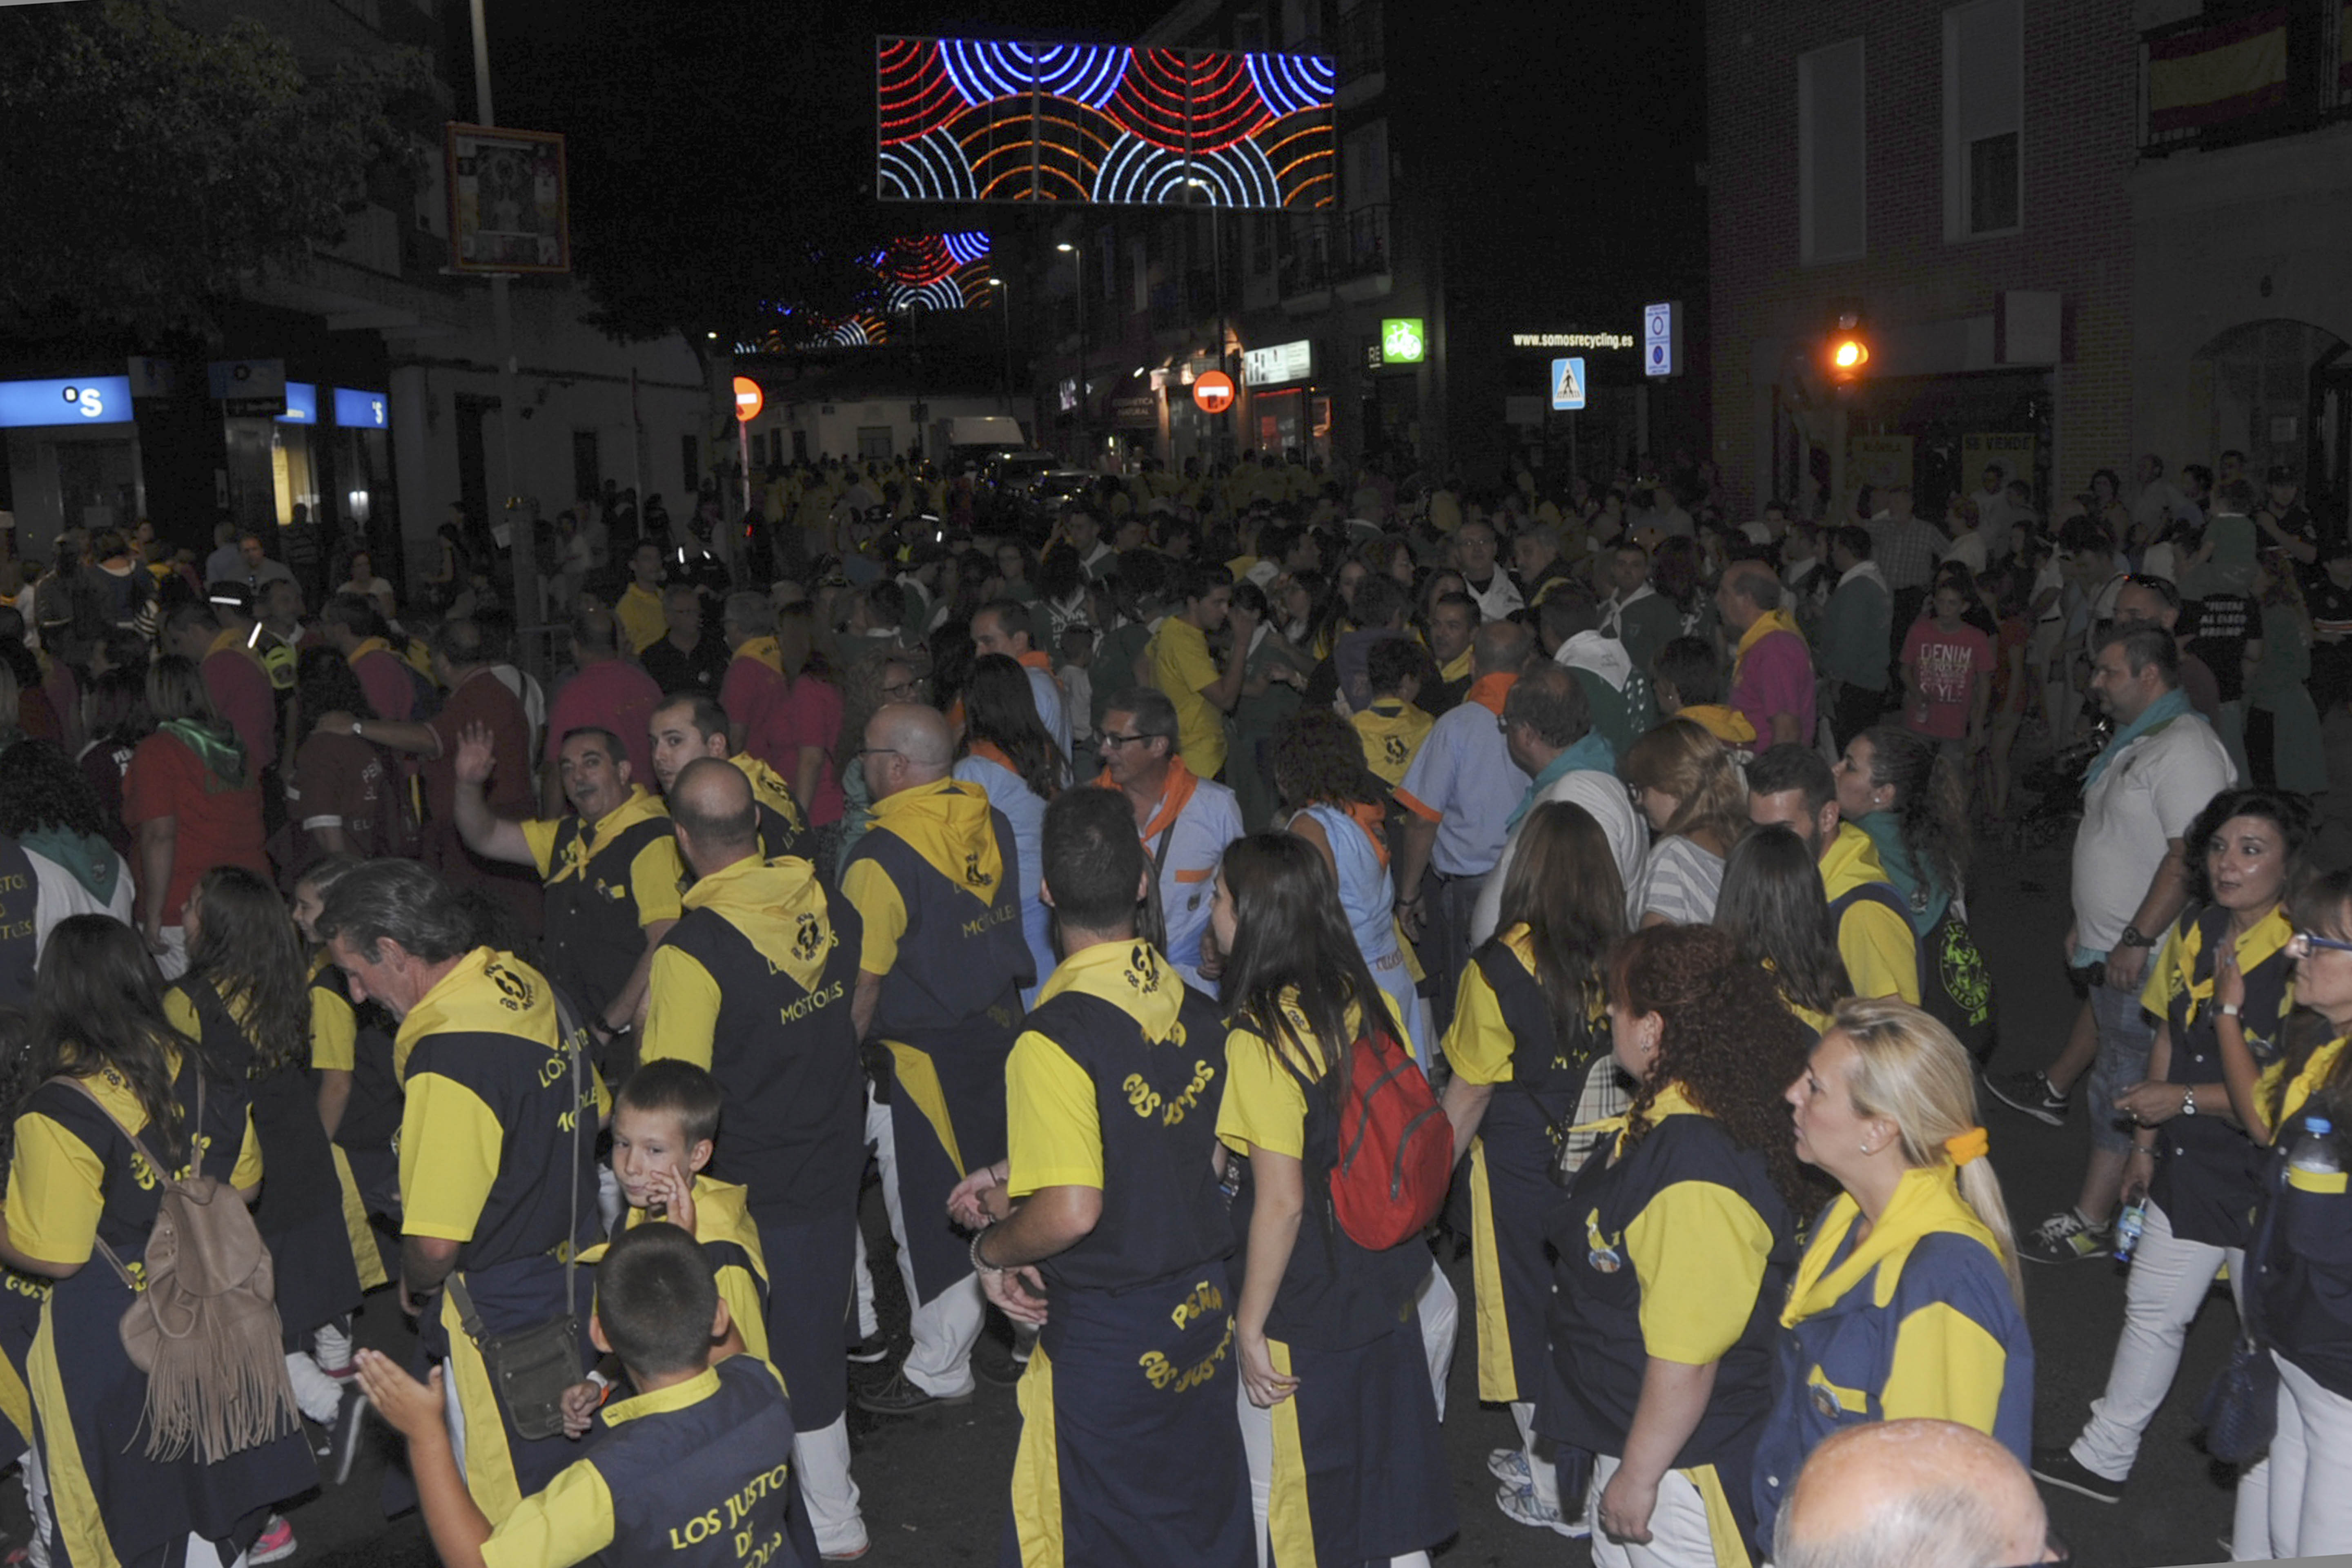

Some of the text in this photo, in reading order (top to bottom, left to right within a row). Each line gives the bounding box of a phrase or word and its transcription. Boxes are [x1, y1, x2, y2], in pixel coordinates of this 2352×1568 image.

[1513, 332, 1634, 350] www.somosrecycling.es
[1921, 643, 1972, 664] DENIM
[1171, 1280, 1223, 1331] PEÑA
[669, 1508, 722, 1550] LOS
